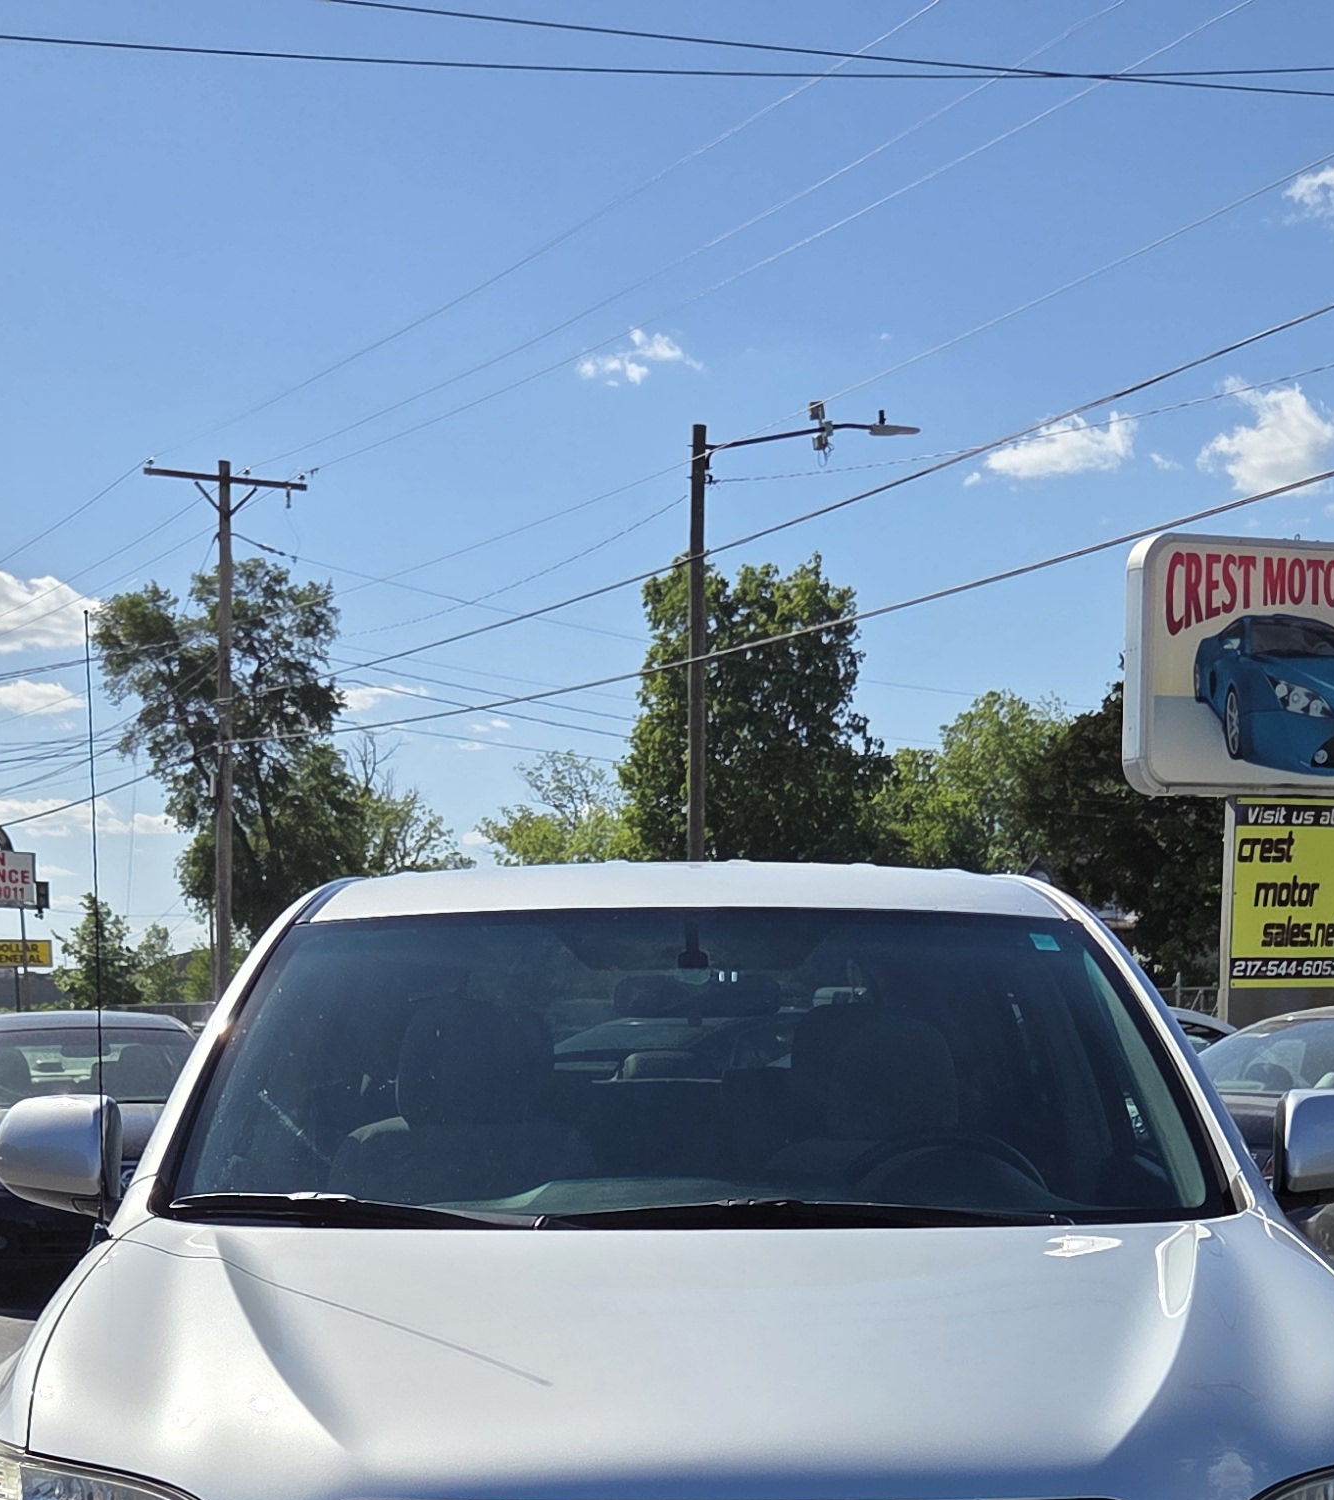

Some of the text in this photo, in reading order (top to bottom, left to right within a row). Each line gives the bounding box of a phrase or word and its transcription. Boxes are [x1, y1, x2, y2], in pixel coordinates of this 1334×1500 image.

[1167, 551, 1256, 636] CREST
[1248, 806, 1286, 824] Visit
[1291, 811, 1315, 825] us
[1237, 831, 1294, 863] crest
[1254, 875, 1320, 907] motor
